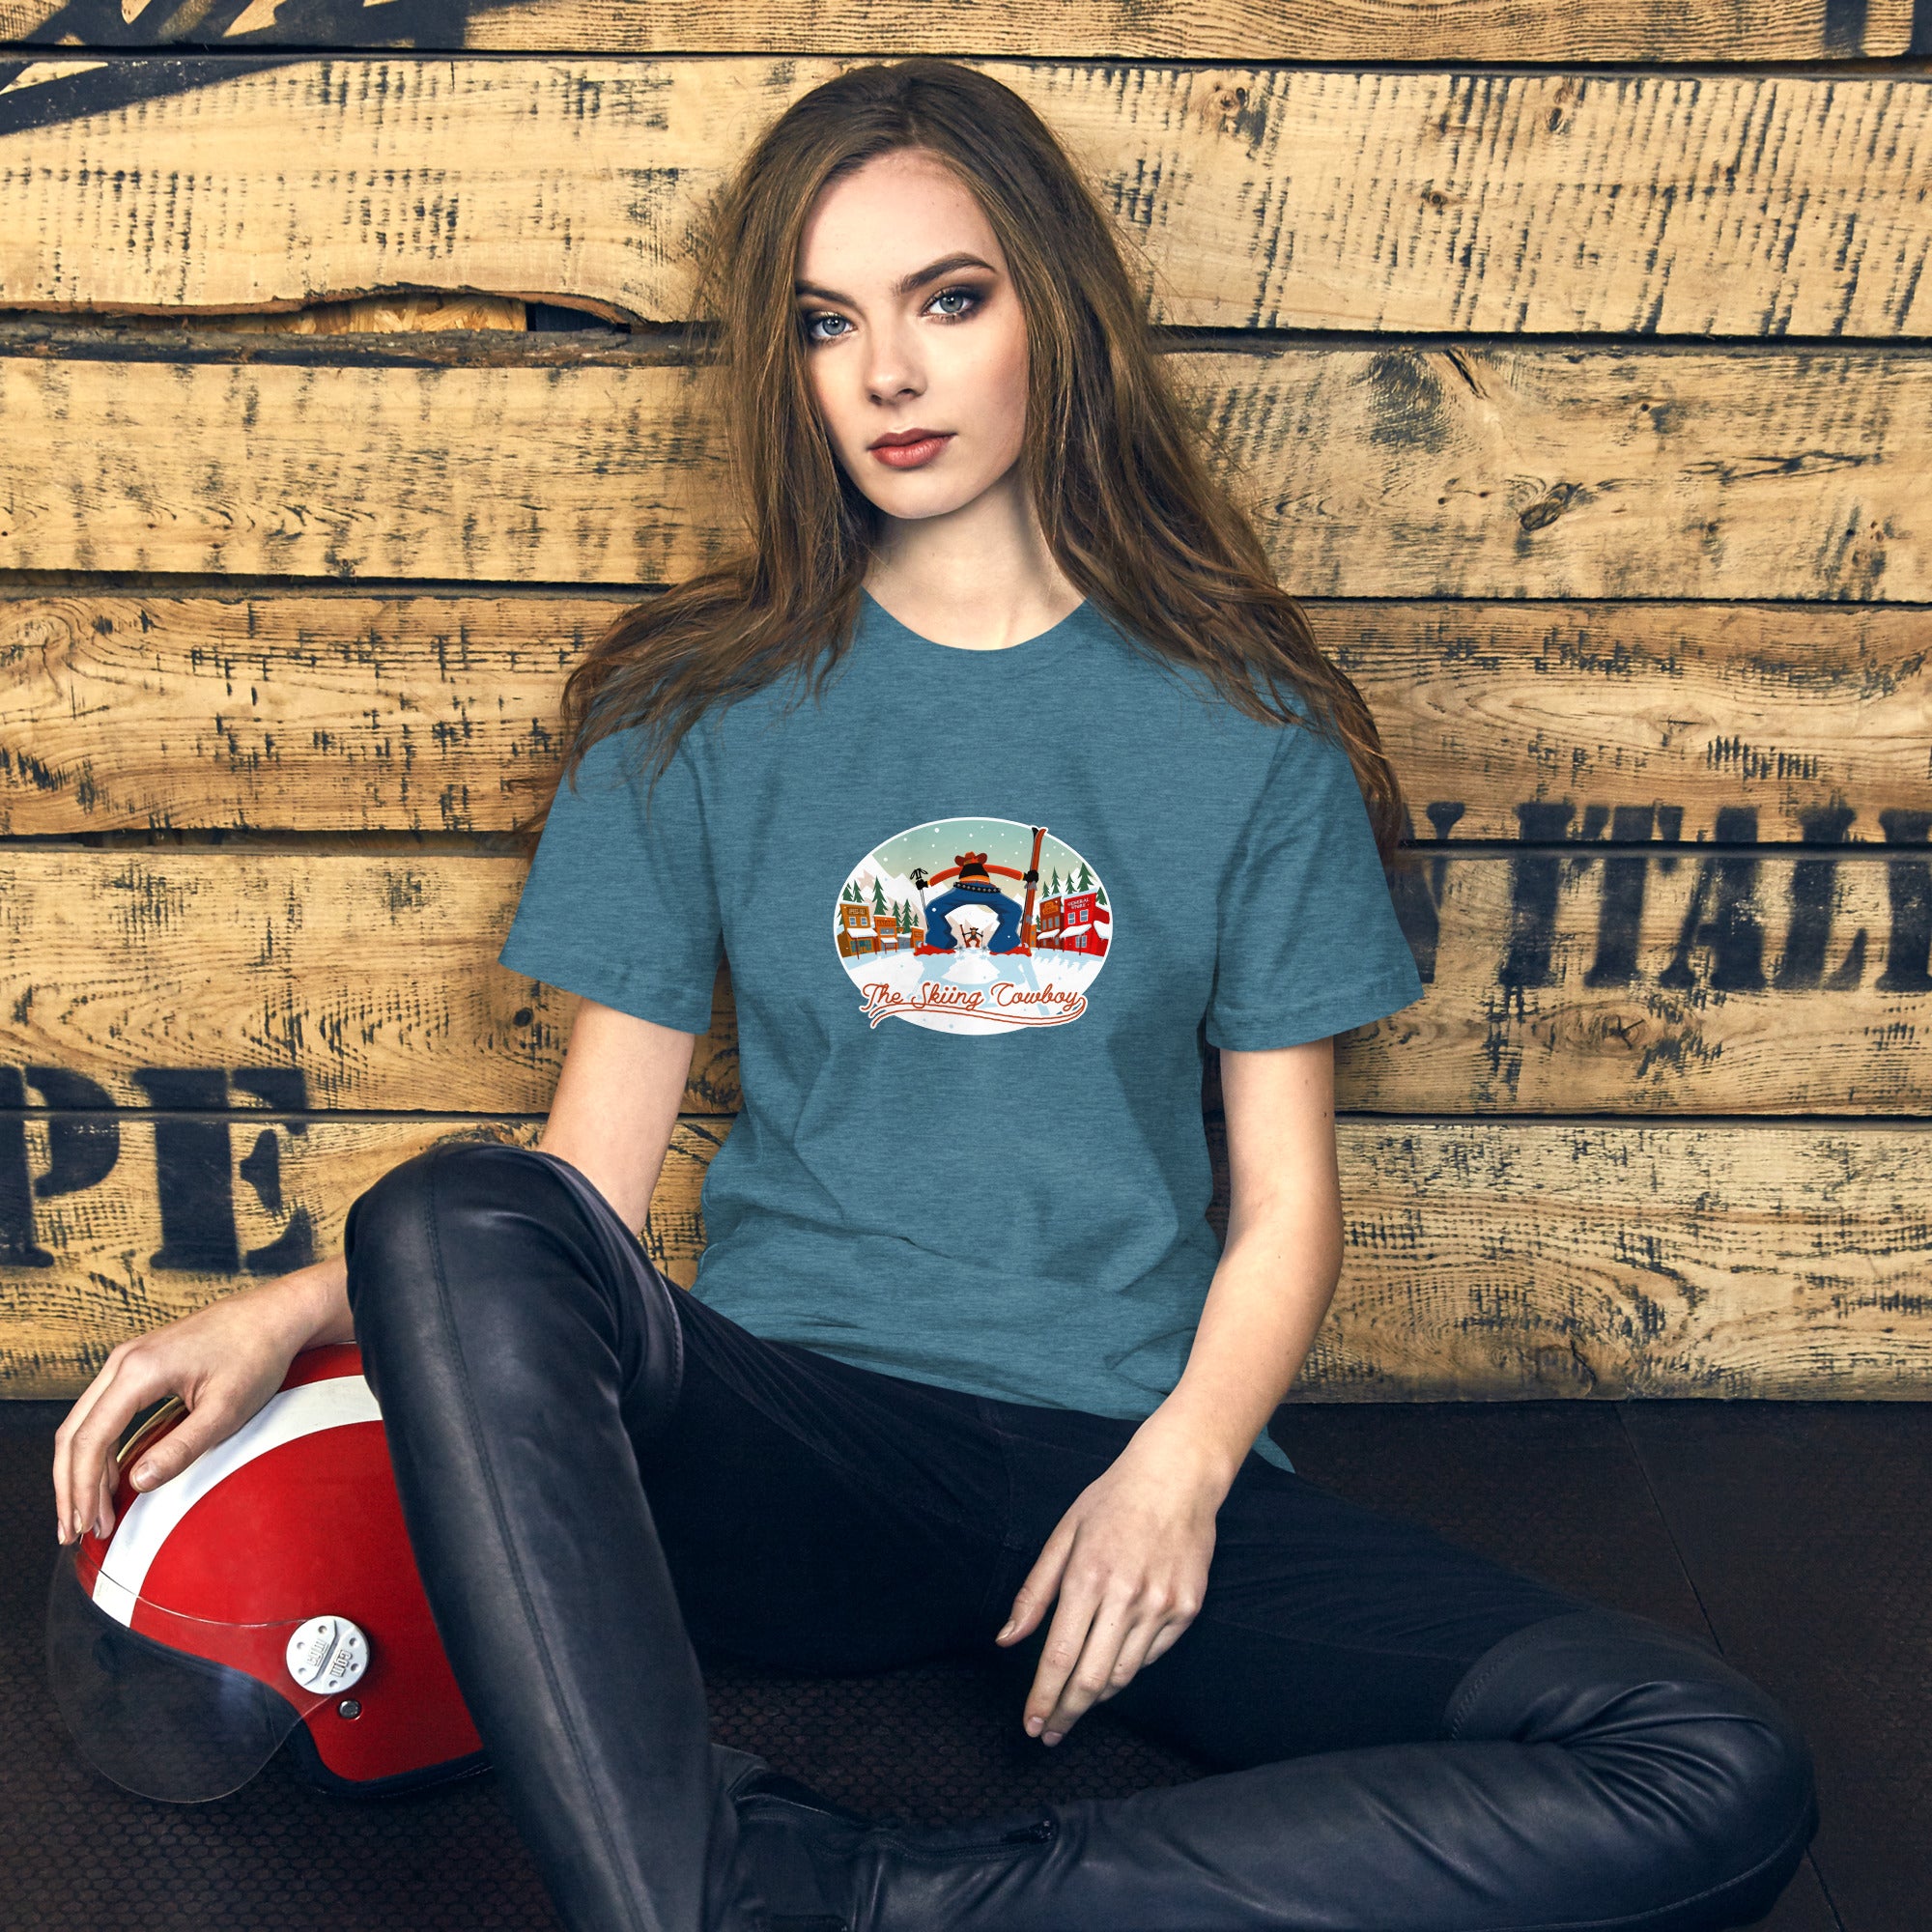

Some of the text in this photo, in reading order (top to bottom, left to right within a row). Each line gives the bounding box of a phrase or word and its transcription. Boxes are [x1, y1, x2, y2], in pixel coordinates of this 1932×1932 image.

[861, 981, 1079, 1011] The Skiing Cowboy
